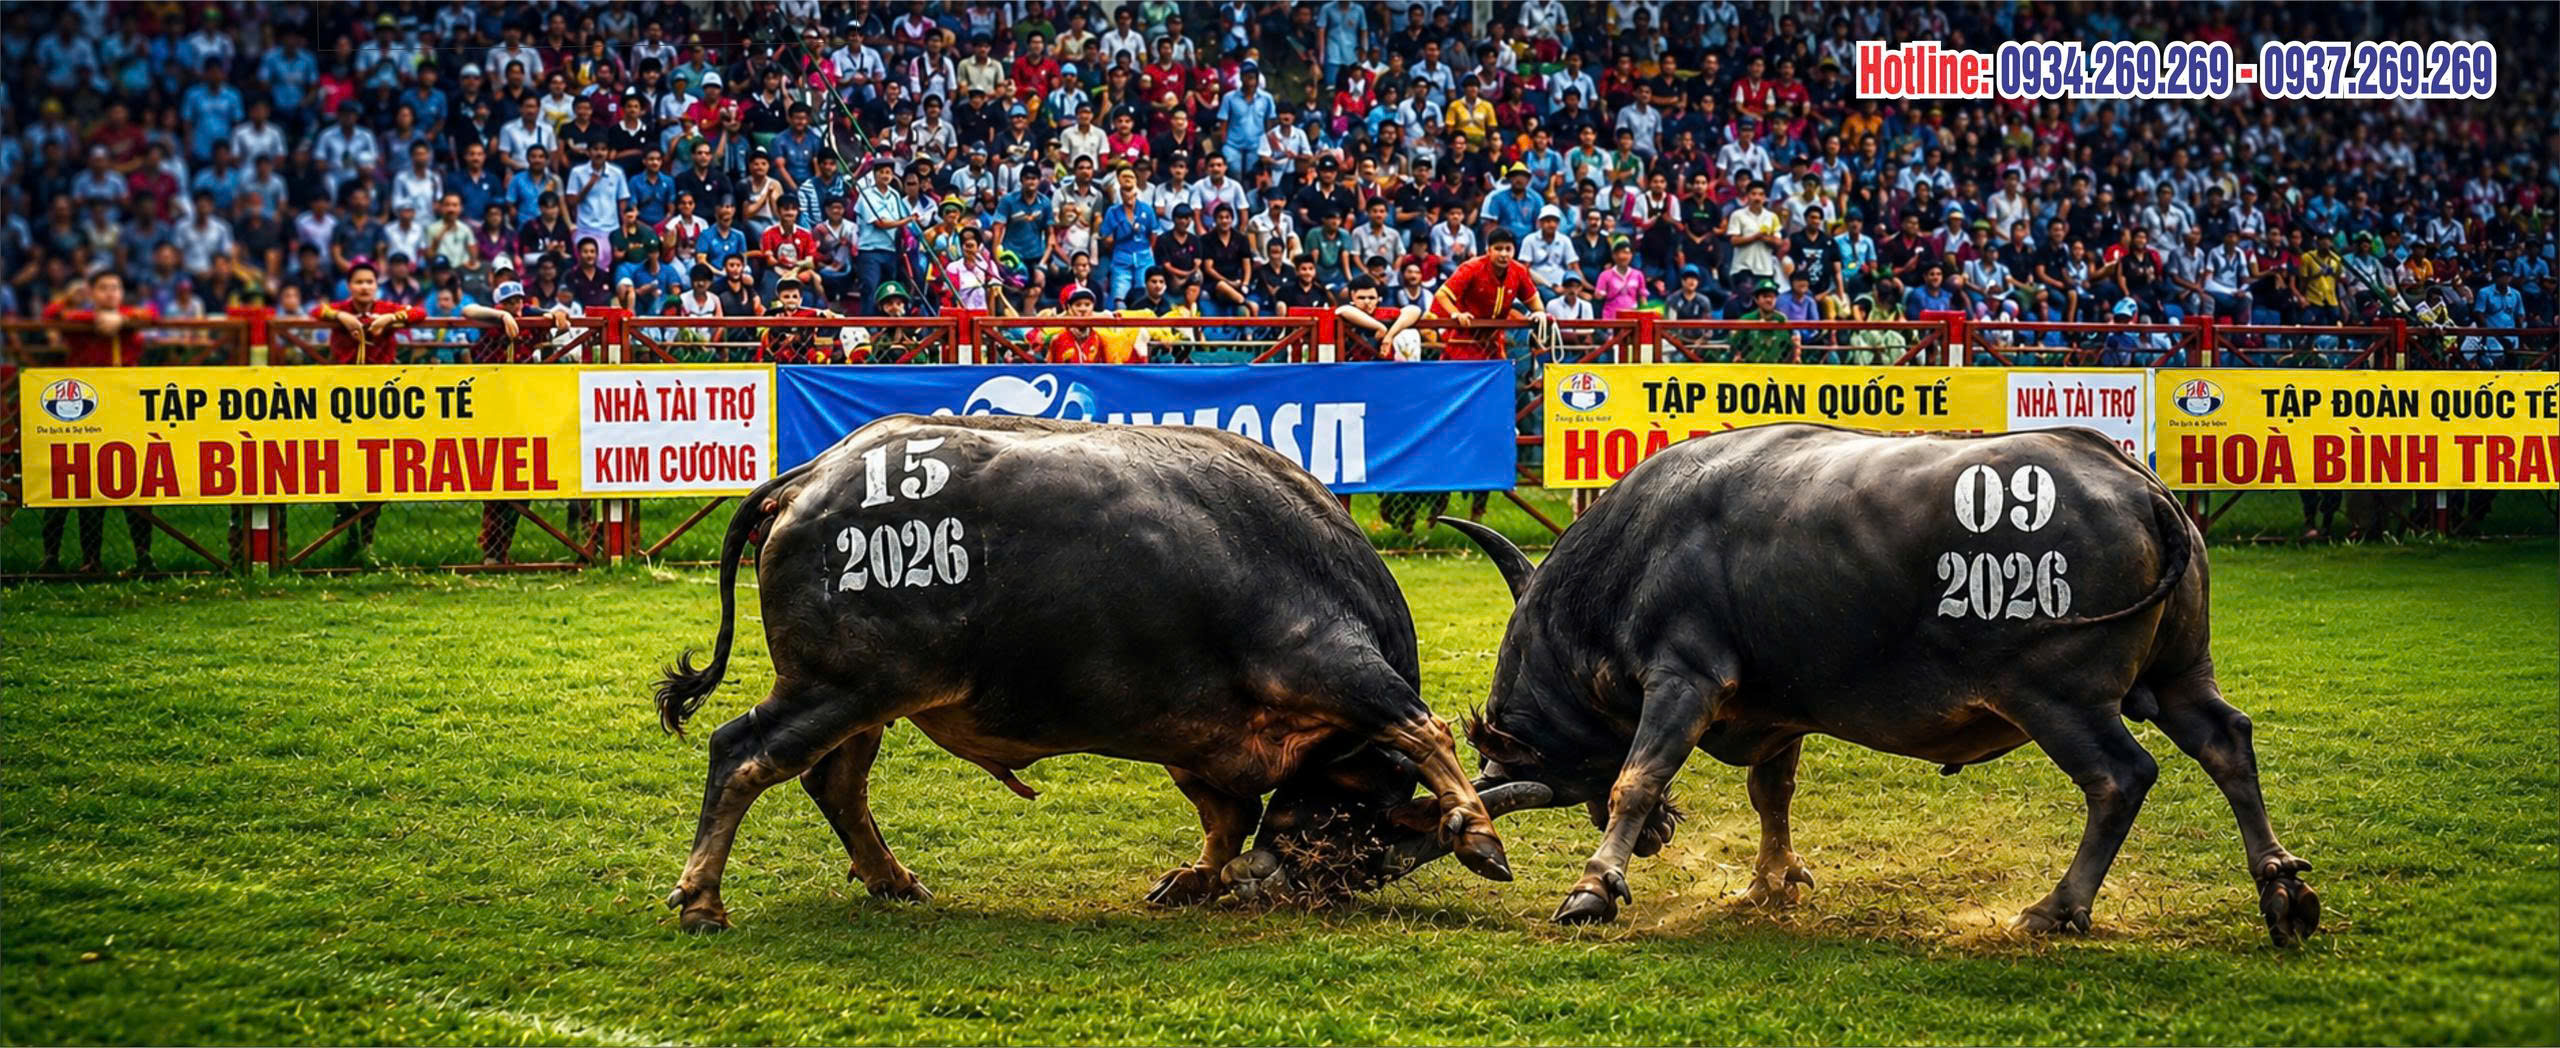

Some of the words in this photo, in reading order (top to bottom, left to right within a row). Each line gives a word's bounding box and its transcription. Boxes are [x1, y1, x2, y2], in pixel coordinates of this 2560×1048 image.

[139, 382, 207, 428] TẬP
[218, 381, 317, 421] ĐOÀN
[330, 377, 426, 424] QUỐC
[435, 377, 475, 419] TẾ
[594, 379, 650, 422] NHÀ
[656, 379, 696, 421] TÀI
[705, 382, 756, 427] TRỢ
[1642, 376, 1706, 419] TẬP
[1716, 377, 1806, 415] ĐOÀN
[1818, 375, 1904, 419] QUỐC
[1914, 376, 1952, 416] TẾ
[2016, 381, 2058, 418] NHÀ
[2063, 381, 2094, 418] TÀI
[2100, 385, 2137, 424] TRỢ
[2260, 383, 2321, 424] TẬP
[2331, 383, 2419, 418] ĐOÀN
[2431, 381, 2516, 422] QUỐC
[2524, 381, 2559, 418] TẾ
[50, 432, 181, 499] HOÀ
[198, 430, 340, 497] BÌNH
[357, 436, 559, 494] TRAVEL
[595, 446, 650, 483] KIM
[659, 441, 756, 483] CƯƠNG
[861, 436, 951, 509] 15
[2180, 426, 2297, 484] HOÀ
[2313, 426, 2439, 484] BÌNH
[1954, 464, 2057, 533] 09
[836, 516, 970, 592] 2026
[1937, 550, 2072, 621] 2026
